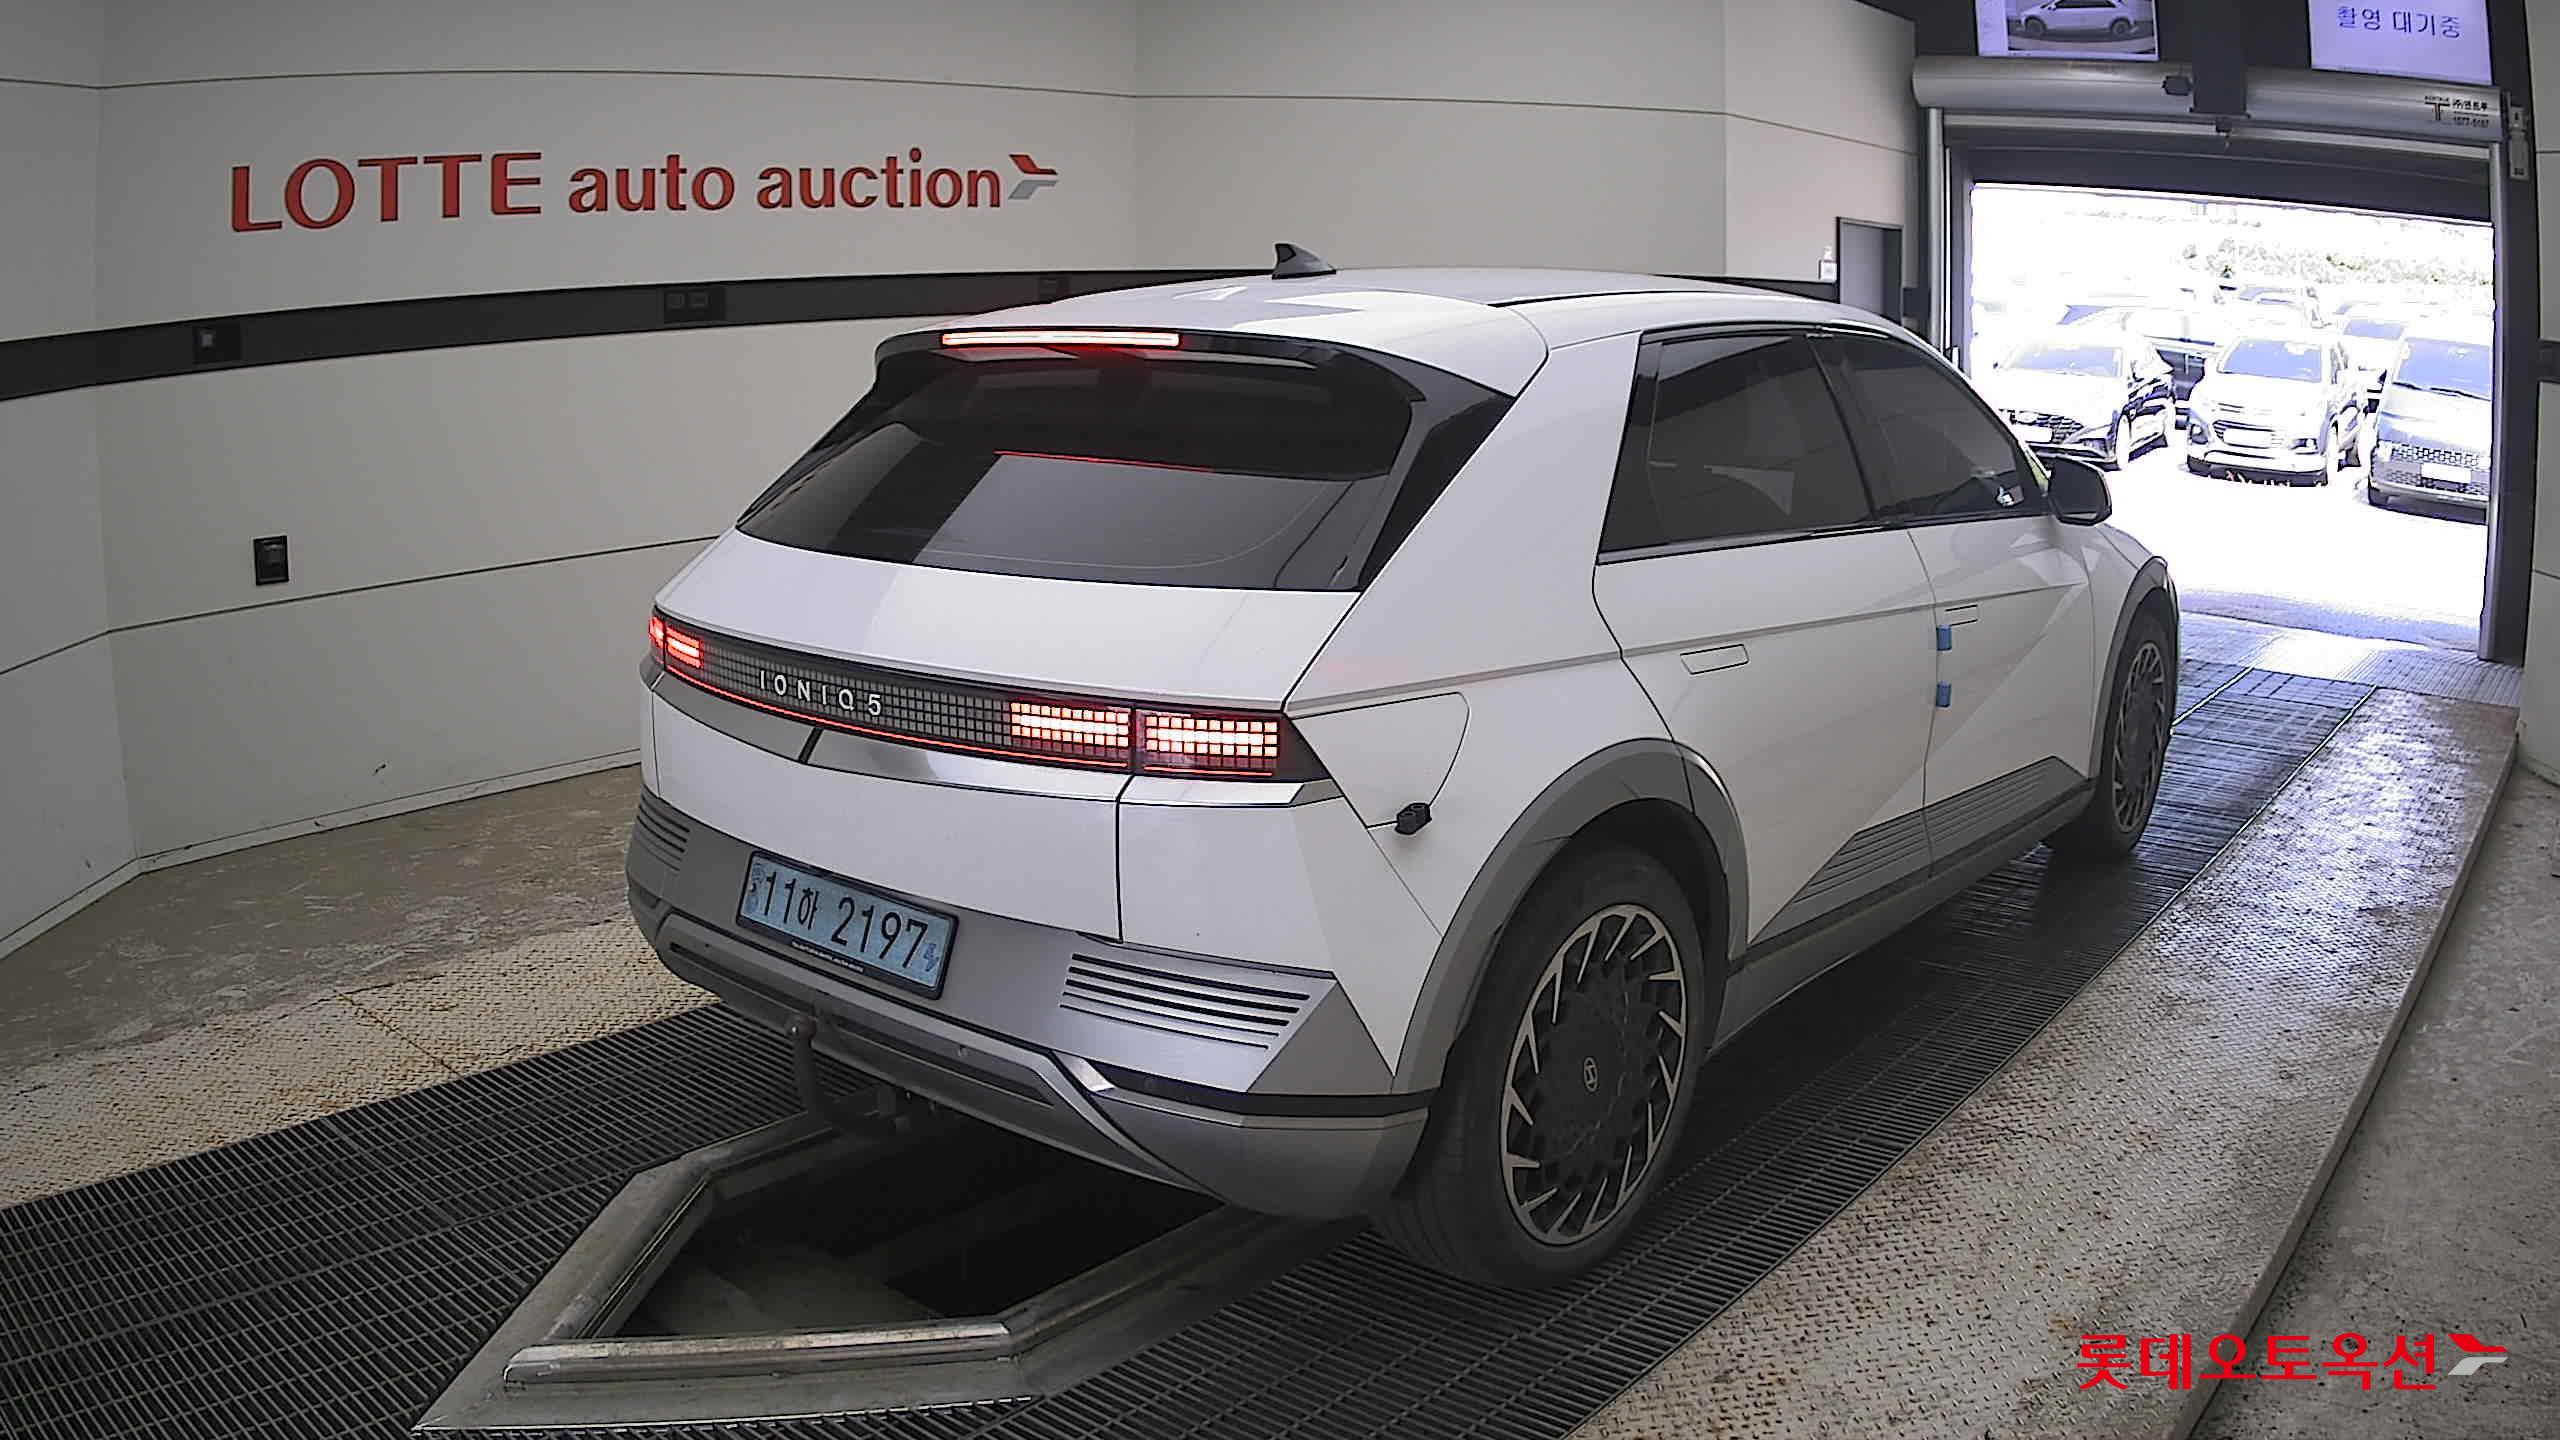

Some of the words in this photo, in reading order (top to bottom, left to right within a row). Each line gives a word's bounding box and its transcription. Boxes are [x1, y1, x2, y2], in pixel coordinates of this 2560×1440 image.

[2337, 5, 2382, 31] 촬영
[2392, 10, 2461, 39] 대기중
[231, 152, 541, 232] LOTTE
[568, 154, 735, 213] auto
[757, 148, 1001, 209] auction
[759, 669, 855, 712] IONIQ
[867, 693, 882, 717] 5
[763, 871, 819, 931] 11하
[830, 896, 929, 969] 2197
